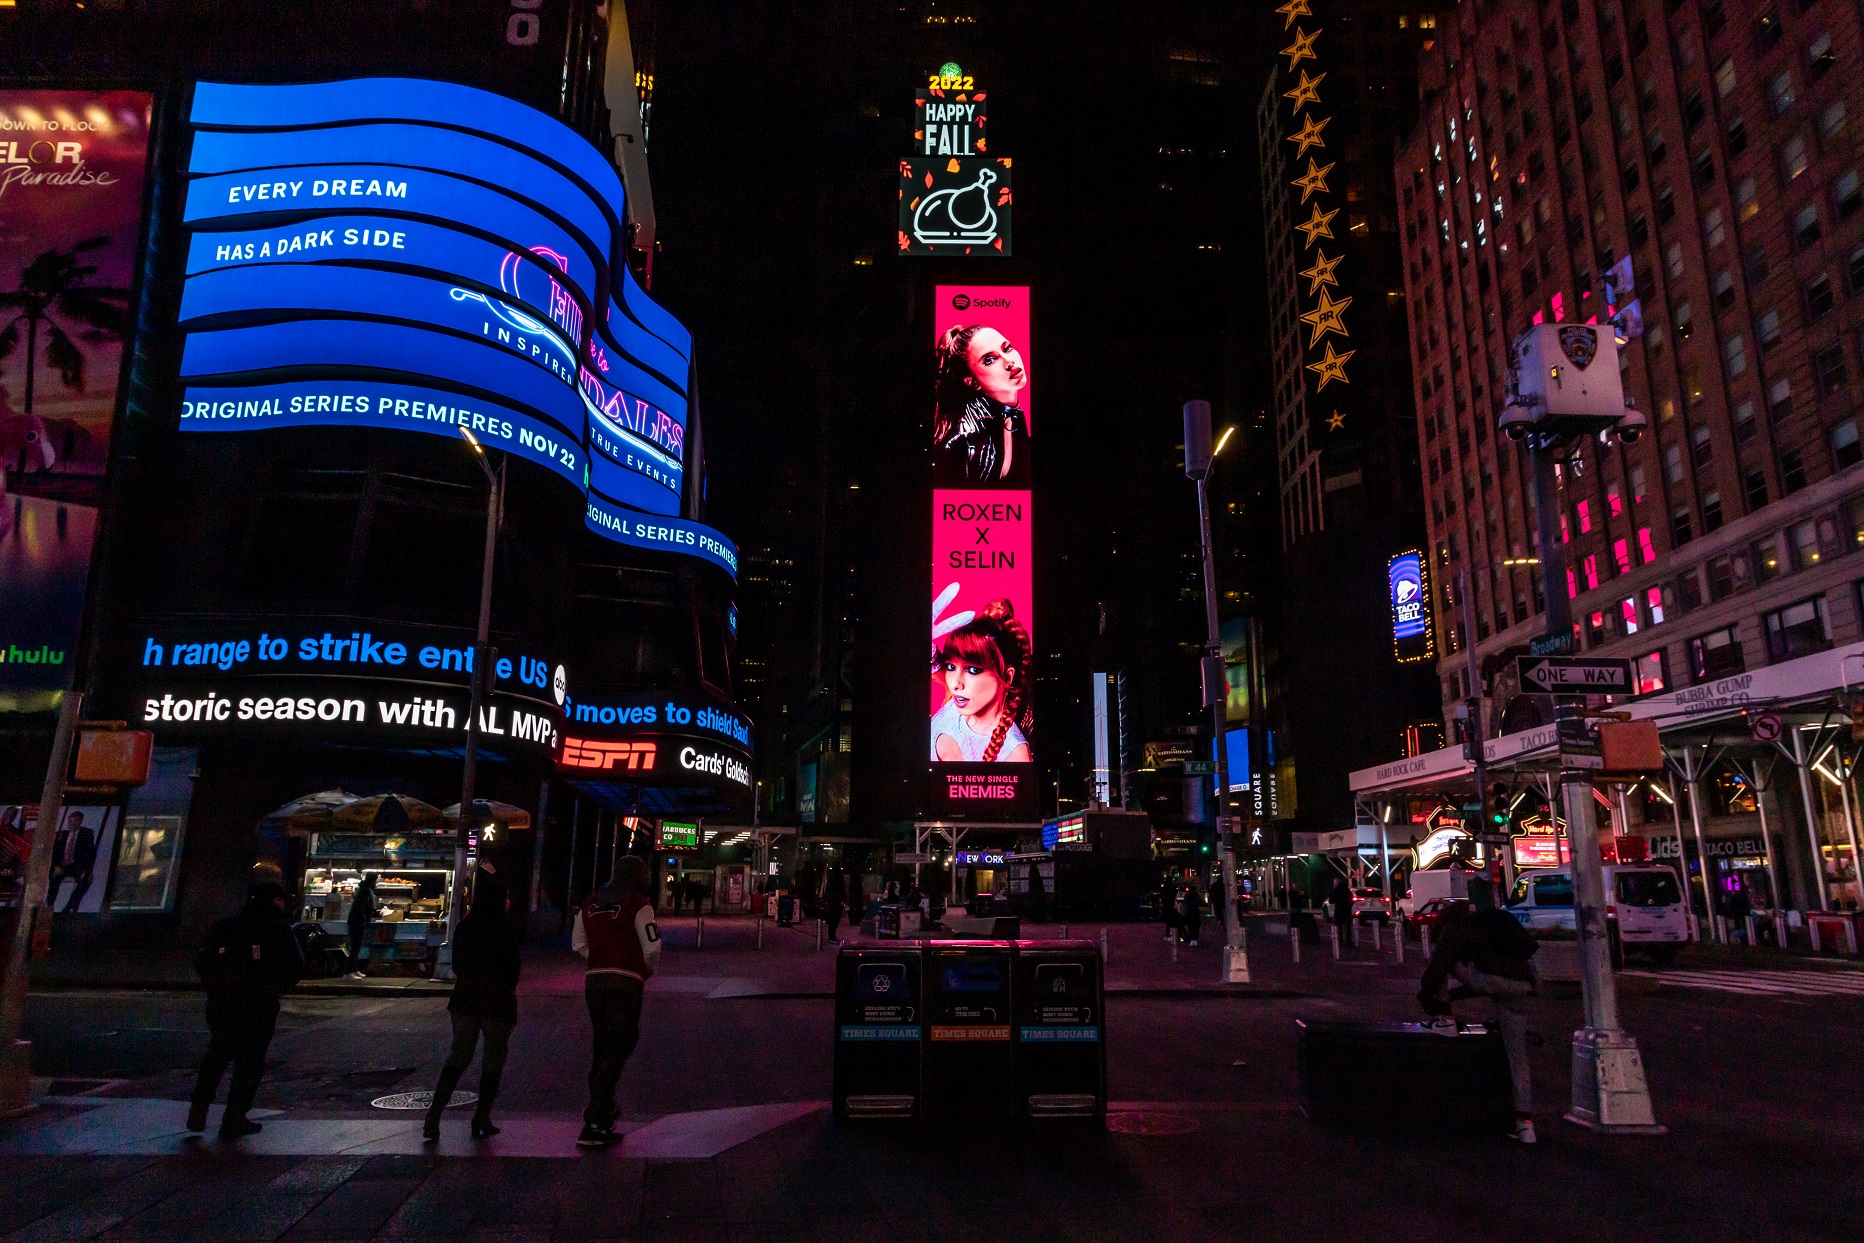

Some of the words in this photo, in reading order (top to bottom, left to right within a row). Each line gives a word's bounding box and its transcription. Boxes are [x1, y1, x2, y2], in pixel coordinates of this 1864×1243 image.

[929, 75, 974, 90] 2022
[925, 103, 976, 122] HAPPY
[0, 120, 37, 131] OWN
[42, 120, 60, 131] TO
[925, 124, 976, 155] FALL
[0, 159, 120, 197] Paradise
[228, 180, 303, 203] EVERY
[312, 179, 408, 199] DREAM
[216, 243, 255, 261] HAS
[259, 241, 271, 258] A
[276, 229, 335, 256] DARK
[343, 228, 406, 250] SIDE
[973, 297, 1012, 309] Spotify
[483, 321, 573, 385] INSPIRED
[591, 427, 619, 458] TRUE
[627, 454, 677, 489] EVENTS
[180, 398, 283, 419] ORIGINAL
[289, 395, 370, 413] SERIES
[378, 397, 513, 439] PREMIERES
[519, 427, 559, 458] NOV
[560, 447, 576, 471] 22
[943, 503, 1021, 521] ROXEN
[635, 524, 695, 545] SERIES
[975, 527, 990, 545] X
[949, 550, 1015, 569] SELIN
[1396, 602, 1421, 615] TACO
[1398, 610, 1422, 623] BELL
[1530, 632, 1572, 656] Broadway
[8, 644, 64, 664] hulu
[143, 637, 164, 666] h
[171, 640, 250, 671] range
[258, 633, 289, 661] to
[298, 632, 407, 665] strike
[418, 645, 513, 680] ente
[520, 655, 548, 688] US
[555, 676, 565, 692] abc
[1536, 667, 1569, 683] ONE
[1583, 667, 1617, 683] WAY
[1675, 685, 1714, 706] BUBBA
[1716, 674, 1752, 695] GUMP
[144, 692, 232, 721] storic
[237, 696, 366, 722] season
[378, 697, 455, 729] with
[511, 710, 552, 744] MVP
[575, 703, 657, 724] moves
[665, 702, 691, 724] to
[696, 706, 732, 735] shield
[562, 736, 657, 770] ESPN
[679, 746, 725, 776] Cards'
[1376, 766, 1393, 781] HARD
[1393, 763, 1409, 777] ROCK
[1409, 759, 1426, 773] CAFE
[1519, 732, 1547, 751] TACO
[1195, 762, 1206, 771] 44
[987, 775, 1018, 783] SINGLE
[949, 784, 1015, 798] ENEMIES
[1253, 773, 1263, 816] SQUARE
[1648, 836, 1681, 859] Lids
[1706, 841, 1735, 856] TACO
[1736, 840, 1767, 854] BELL
[843, 1029, 876, 1038] TIMES
[878, 1029, 918, 1038] SQUARE
[933, 1029, 967, 1038] TIMES
[968, 1029, 1009, 1038] SQUARE
[1021, 1030, 1055, 1039] TIMES
[1057, 1030, 1095, 1039] SQUARE
